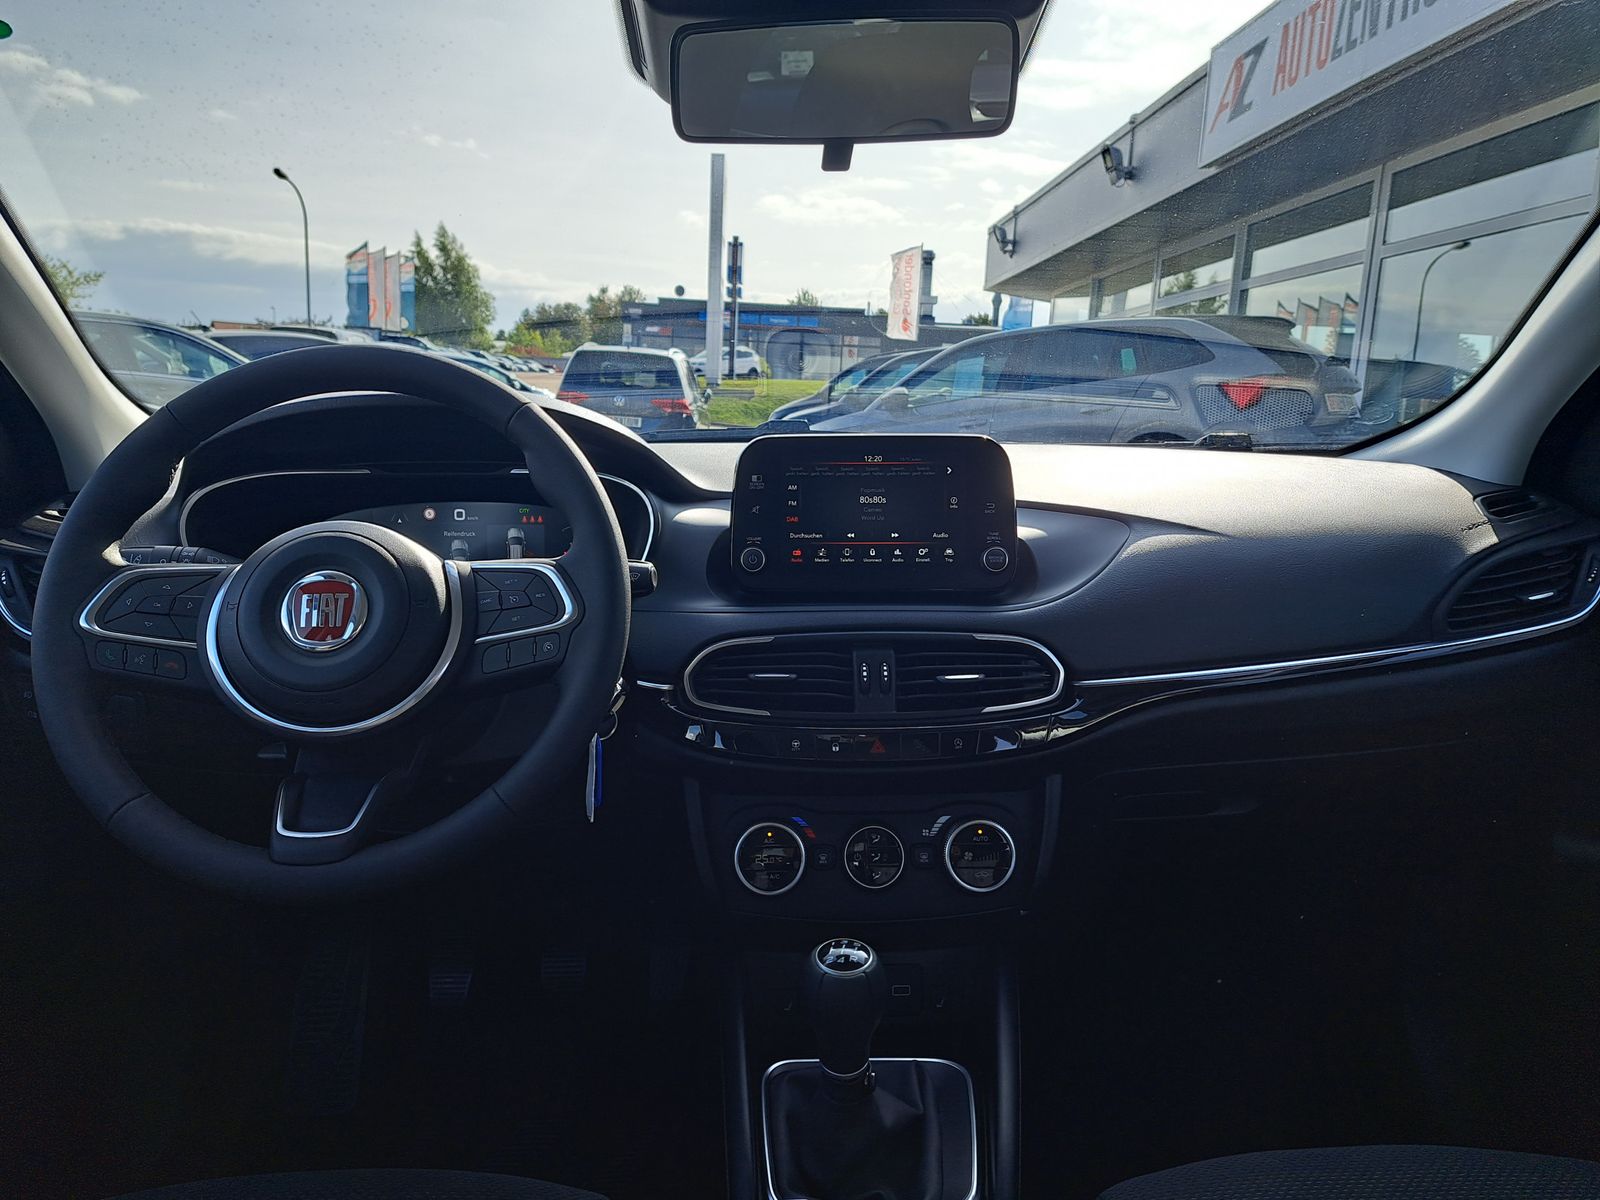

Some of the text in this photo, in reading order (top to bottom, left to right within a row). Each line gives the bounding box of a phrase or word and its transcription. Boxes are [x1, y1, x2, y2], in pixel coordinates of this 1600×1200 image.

[859, 495, 887, 504] 80s80s
[443, 530, 476, 538] Reifendruck
[300, 592, 349, 628] FIAT
